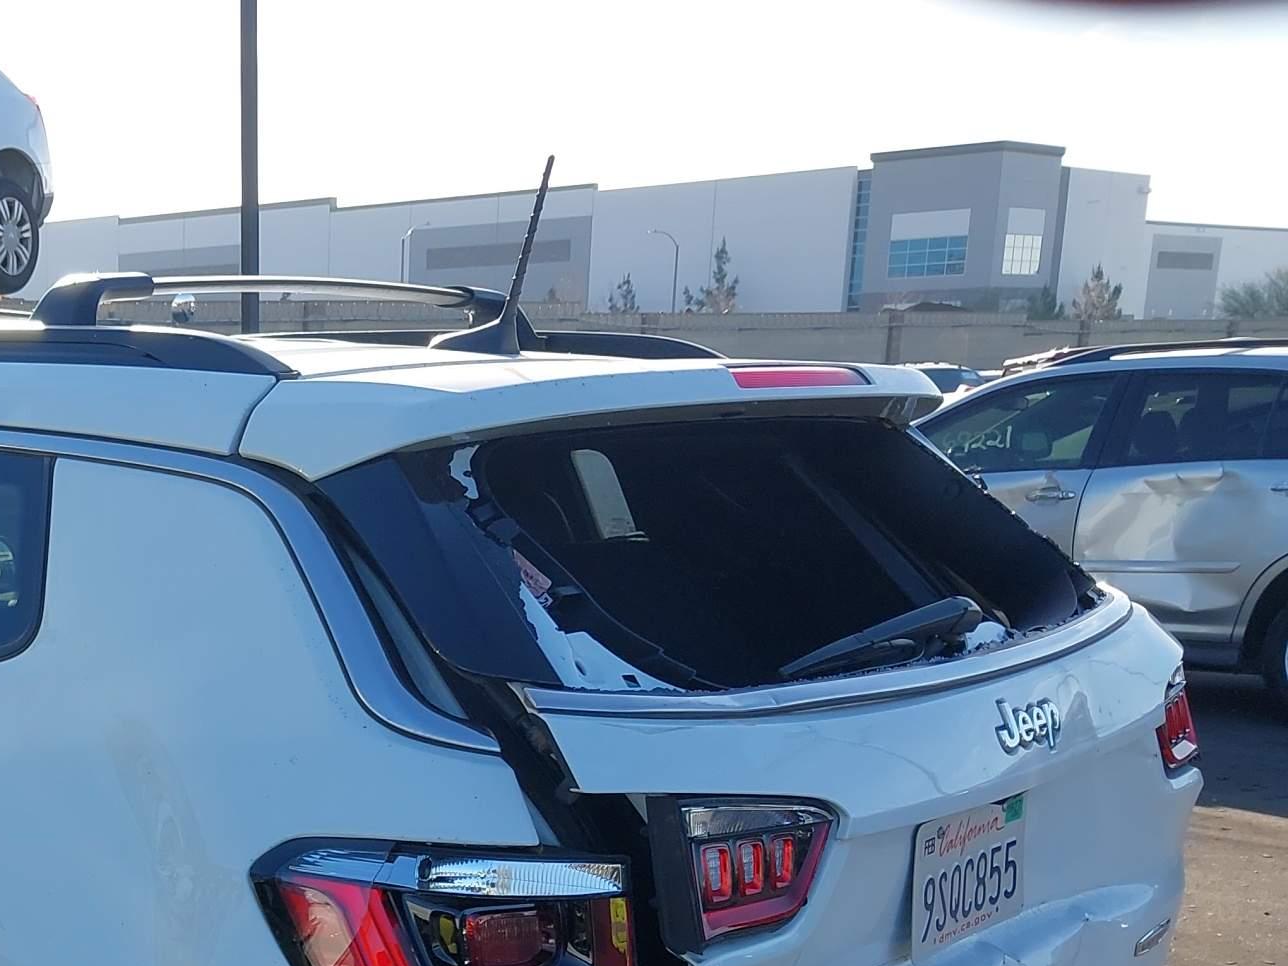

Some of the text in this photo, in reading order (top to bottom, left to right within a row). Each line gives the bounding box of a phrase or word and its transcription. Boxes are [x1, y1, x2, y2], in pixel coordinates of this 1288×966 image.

[995, 699, 1061, 755] Jeep
[939, 815, 1006, 857] California
[921, 839, 1018, 943] 9SQC855
[938, 911, 993, 943] dmv.ca.gov
